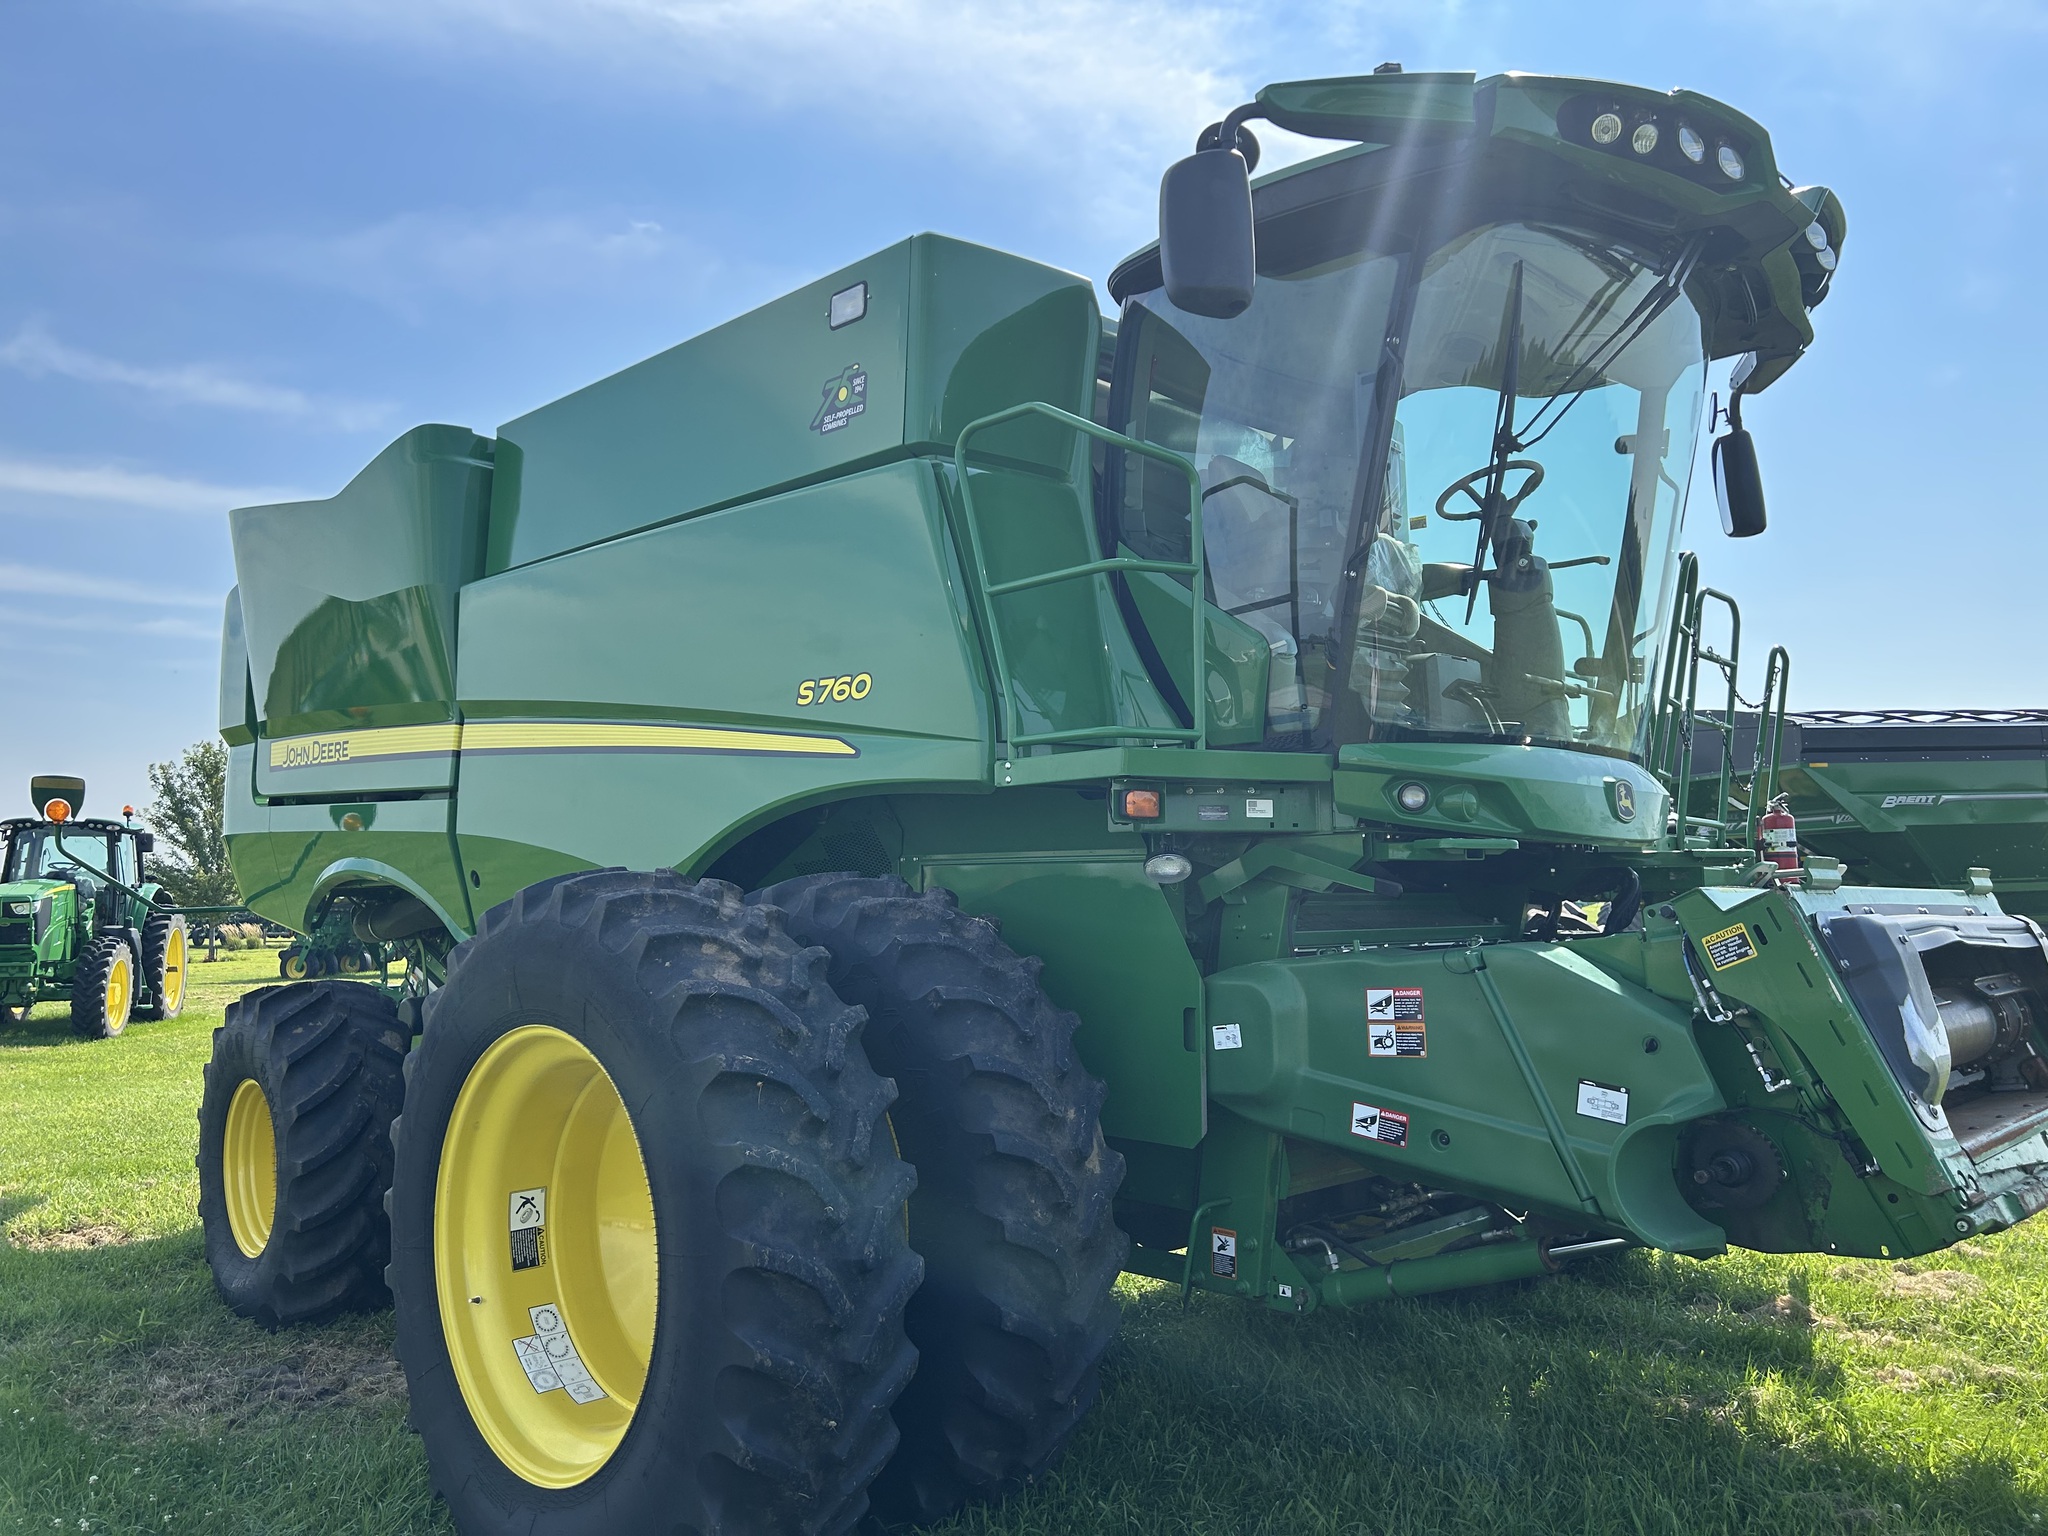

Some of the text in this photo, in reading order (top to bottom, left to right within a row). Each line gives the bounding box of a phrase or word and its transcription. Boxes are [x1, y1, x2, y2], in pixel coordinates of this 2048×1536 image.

[823, 404, 863, 423] SELF-PROPELLED
[822, 417, 847, 431] COMBINES
[796, 672, 873, 706] S760
[283, 740, 349, 765] JOHN DEERE
[1881, 795, 1937, 808] BRENT
[1709, 925, 1743, 942] CAUTION
[1385, 1112, 1407, 1122] DANGER
[538, 1235, 547, 1265] CAUTION
